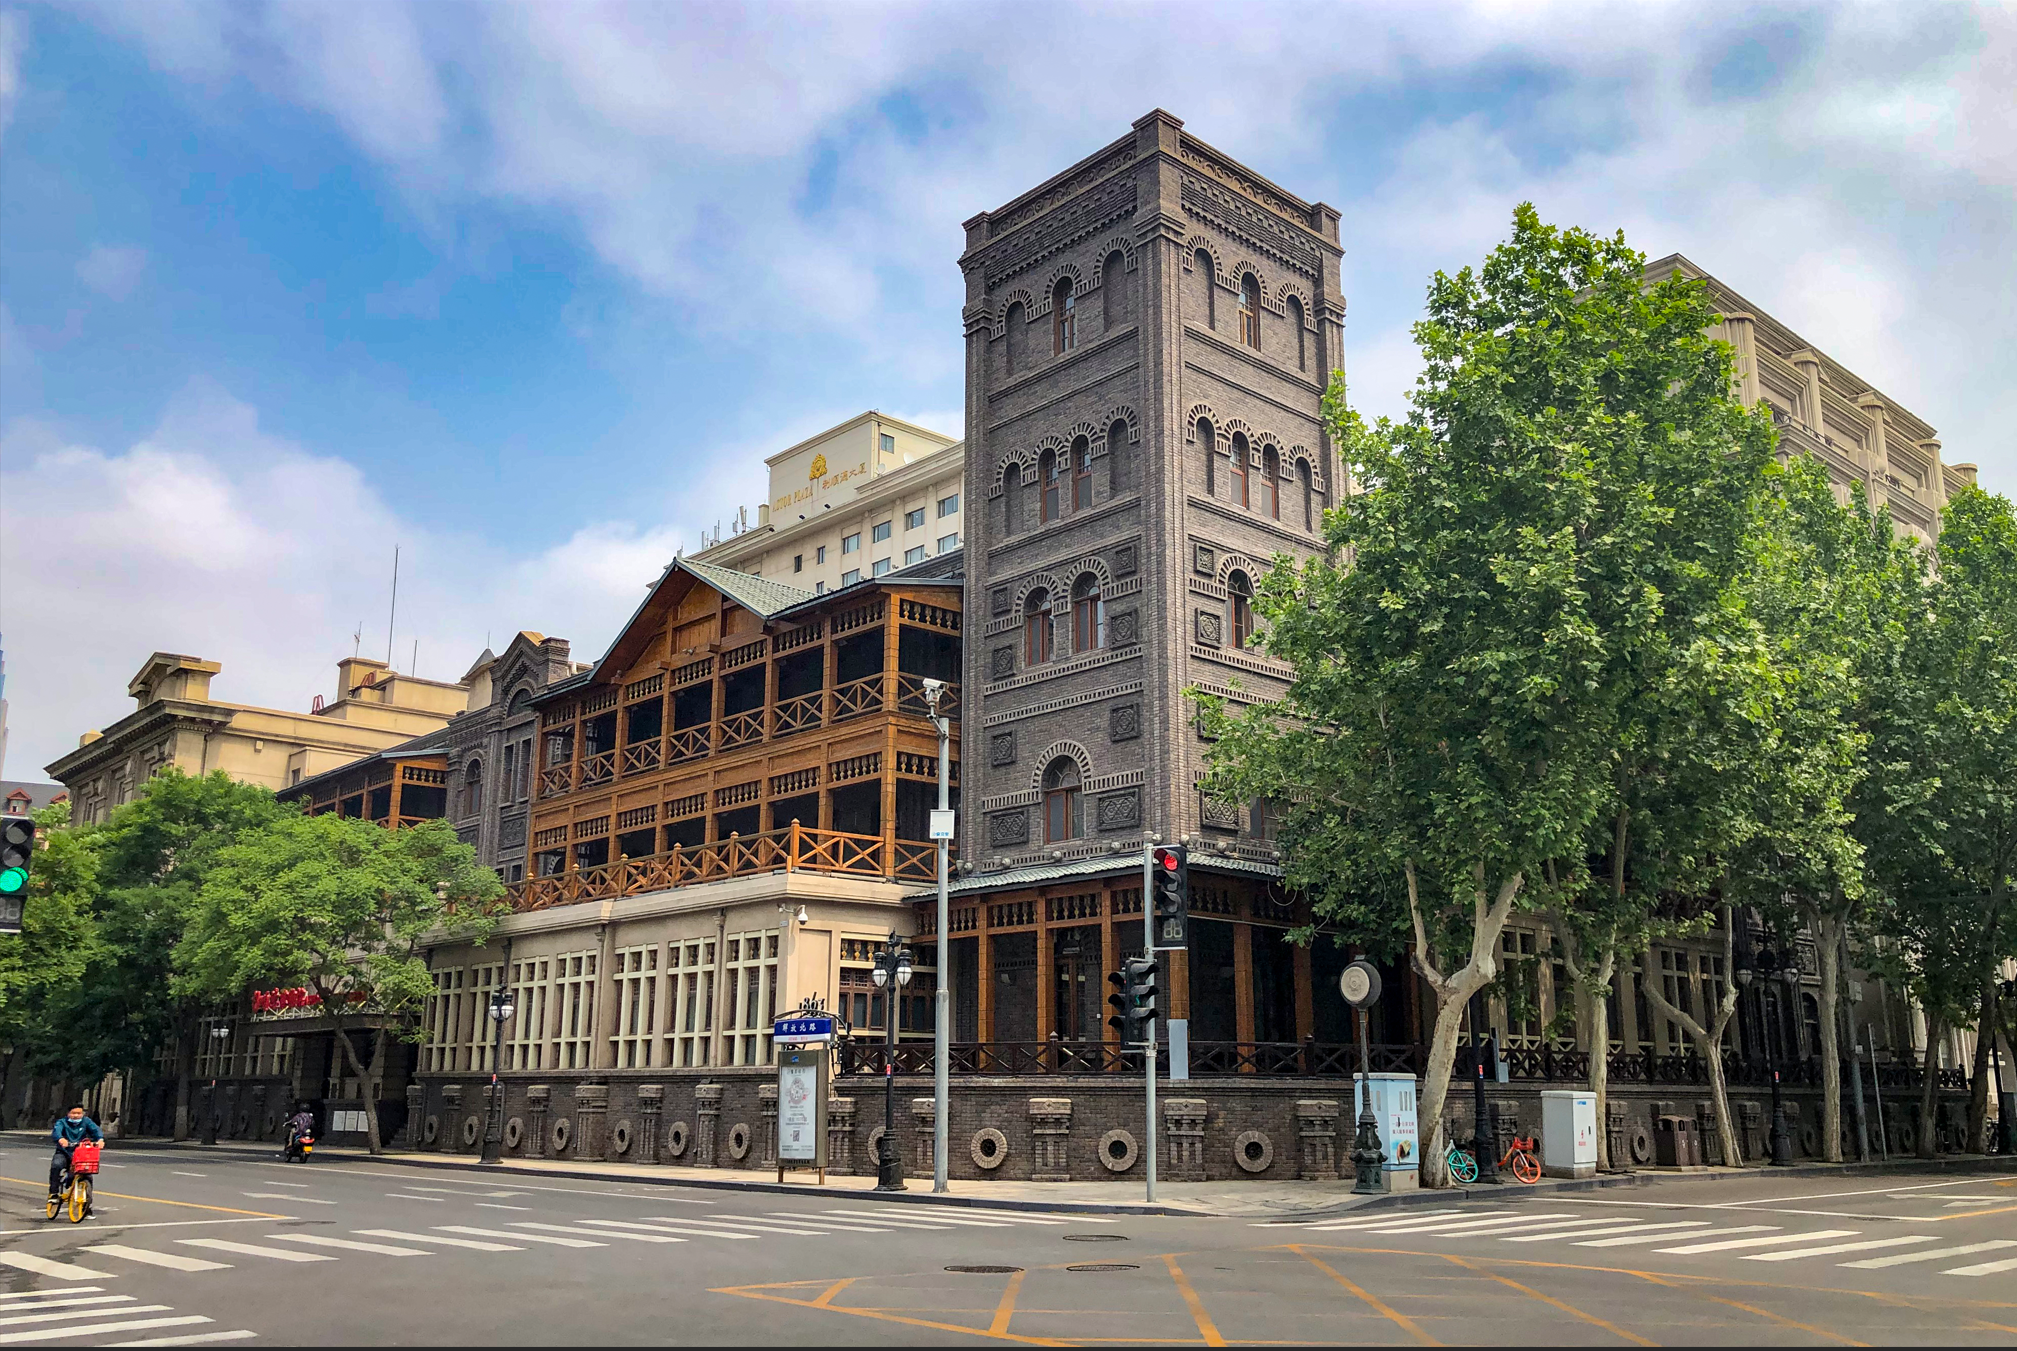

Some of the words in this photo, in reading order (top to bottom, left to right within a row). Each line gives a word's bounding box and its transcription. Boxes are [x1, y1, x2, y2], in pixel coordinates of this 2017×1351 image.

[794, 485, 813, 504] PLAZA
[782, 1022, 817, 1033] 解放北路
